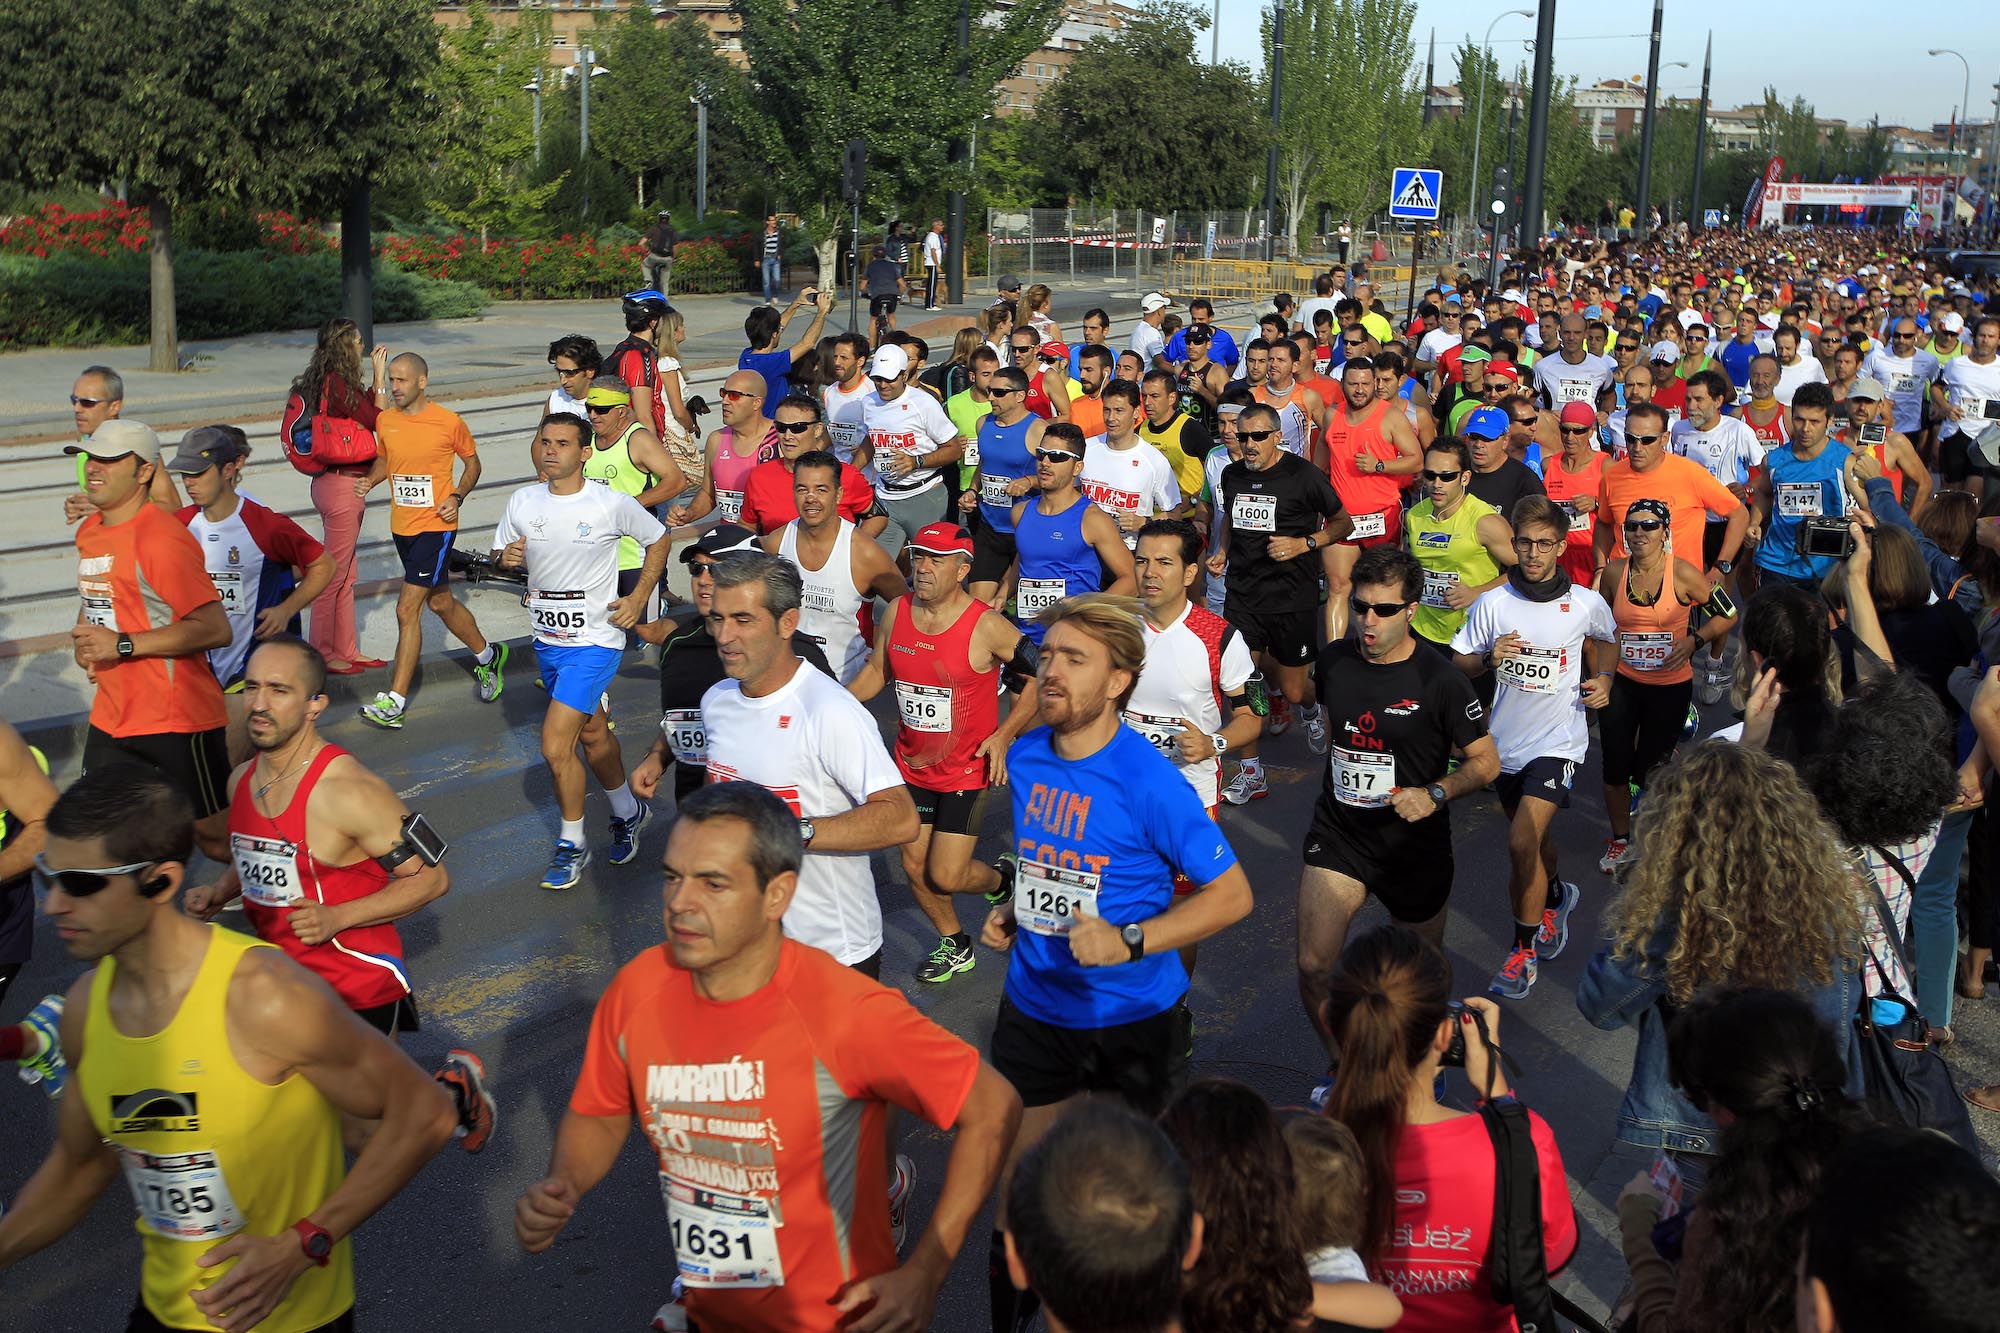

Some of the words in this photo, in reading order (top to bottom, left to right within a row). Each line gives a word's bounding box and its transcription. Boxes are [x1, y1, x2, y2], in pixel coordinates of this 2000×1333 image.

[1766, 186, 1782, 201] 31
[1924, 189, 1942, 204] 31
[1564, 387, 1588, 397] 1876
[831, 431, 853, 441] 1957
[397, 486, 425, 497] 1231
[984, 486, 1006, 498] 1809
[1783, 495, 1815, 506] 2147
[719, 501, 742, 514] 276
[1238, 507, 1269, 520] 1600
[805, 584, 836, 595] DEPORTES
[805, 595, 835, 608] OLIMPO
[1023, 594, 1057, 607] 1938
[534, 610, 585, 628] 2805
[914, 640, 936, 651] Joma
[1625, 646, 1666, 659] 5125
[905, 700, 936, 718] 516
[671, 730, 708, 748] 159
[1341, 770, 1376, 791] 617
[241, 860, 288, 888] 2428
[672, 1218, 753, 1261] 1631
